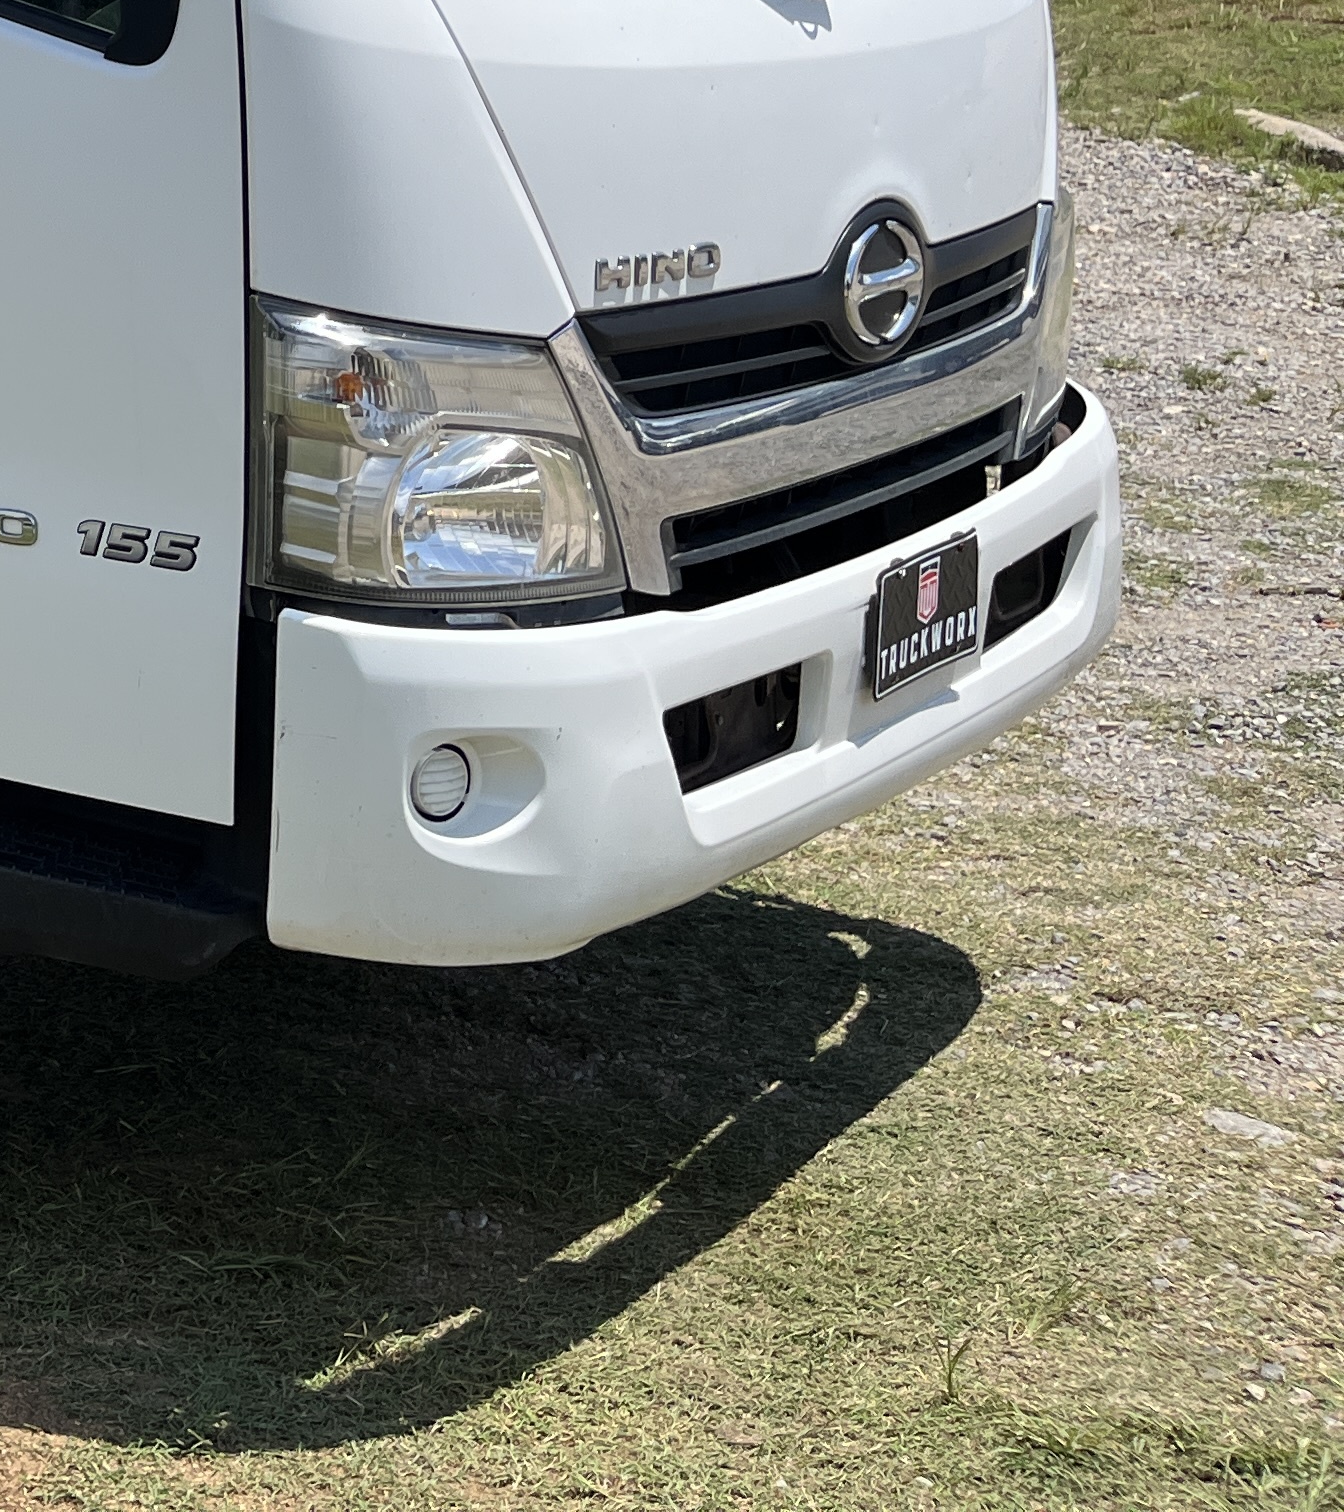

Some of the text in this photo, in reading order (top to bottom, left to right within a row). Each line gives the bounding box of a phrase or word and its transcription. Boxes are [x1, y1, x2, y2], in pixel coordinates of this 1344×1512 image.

[595, 241, 721, 291] HINO
[77, 519, 201, 572] 155
[880, 605, 977, 680] TRUCKWORX
